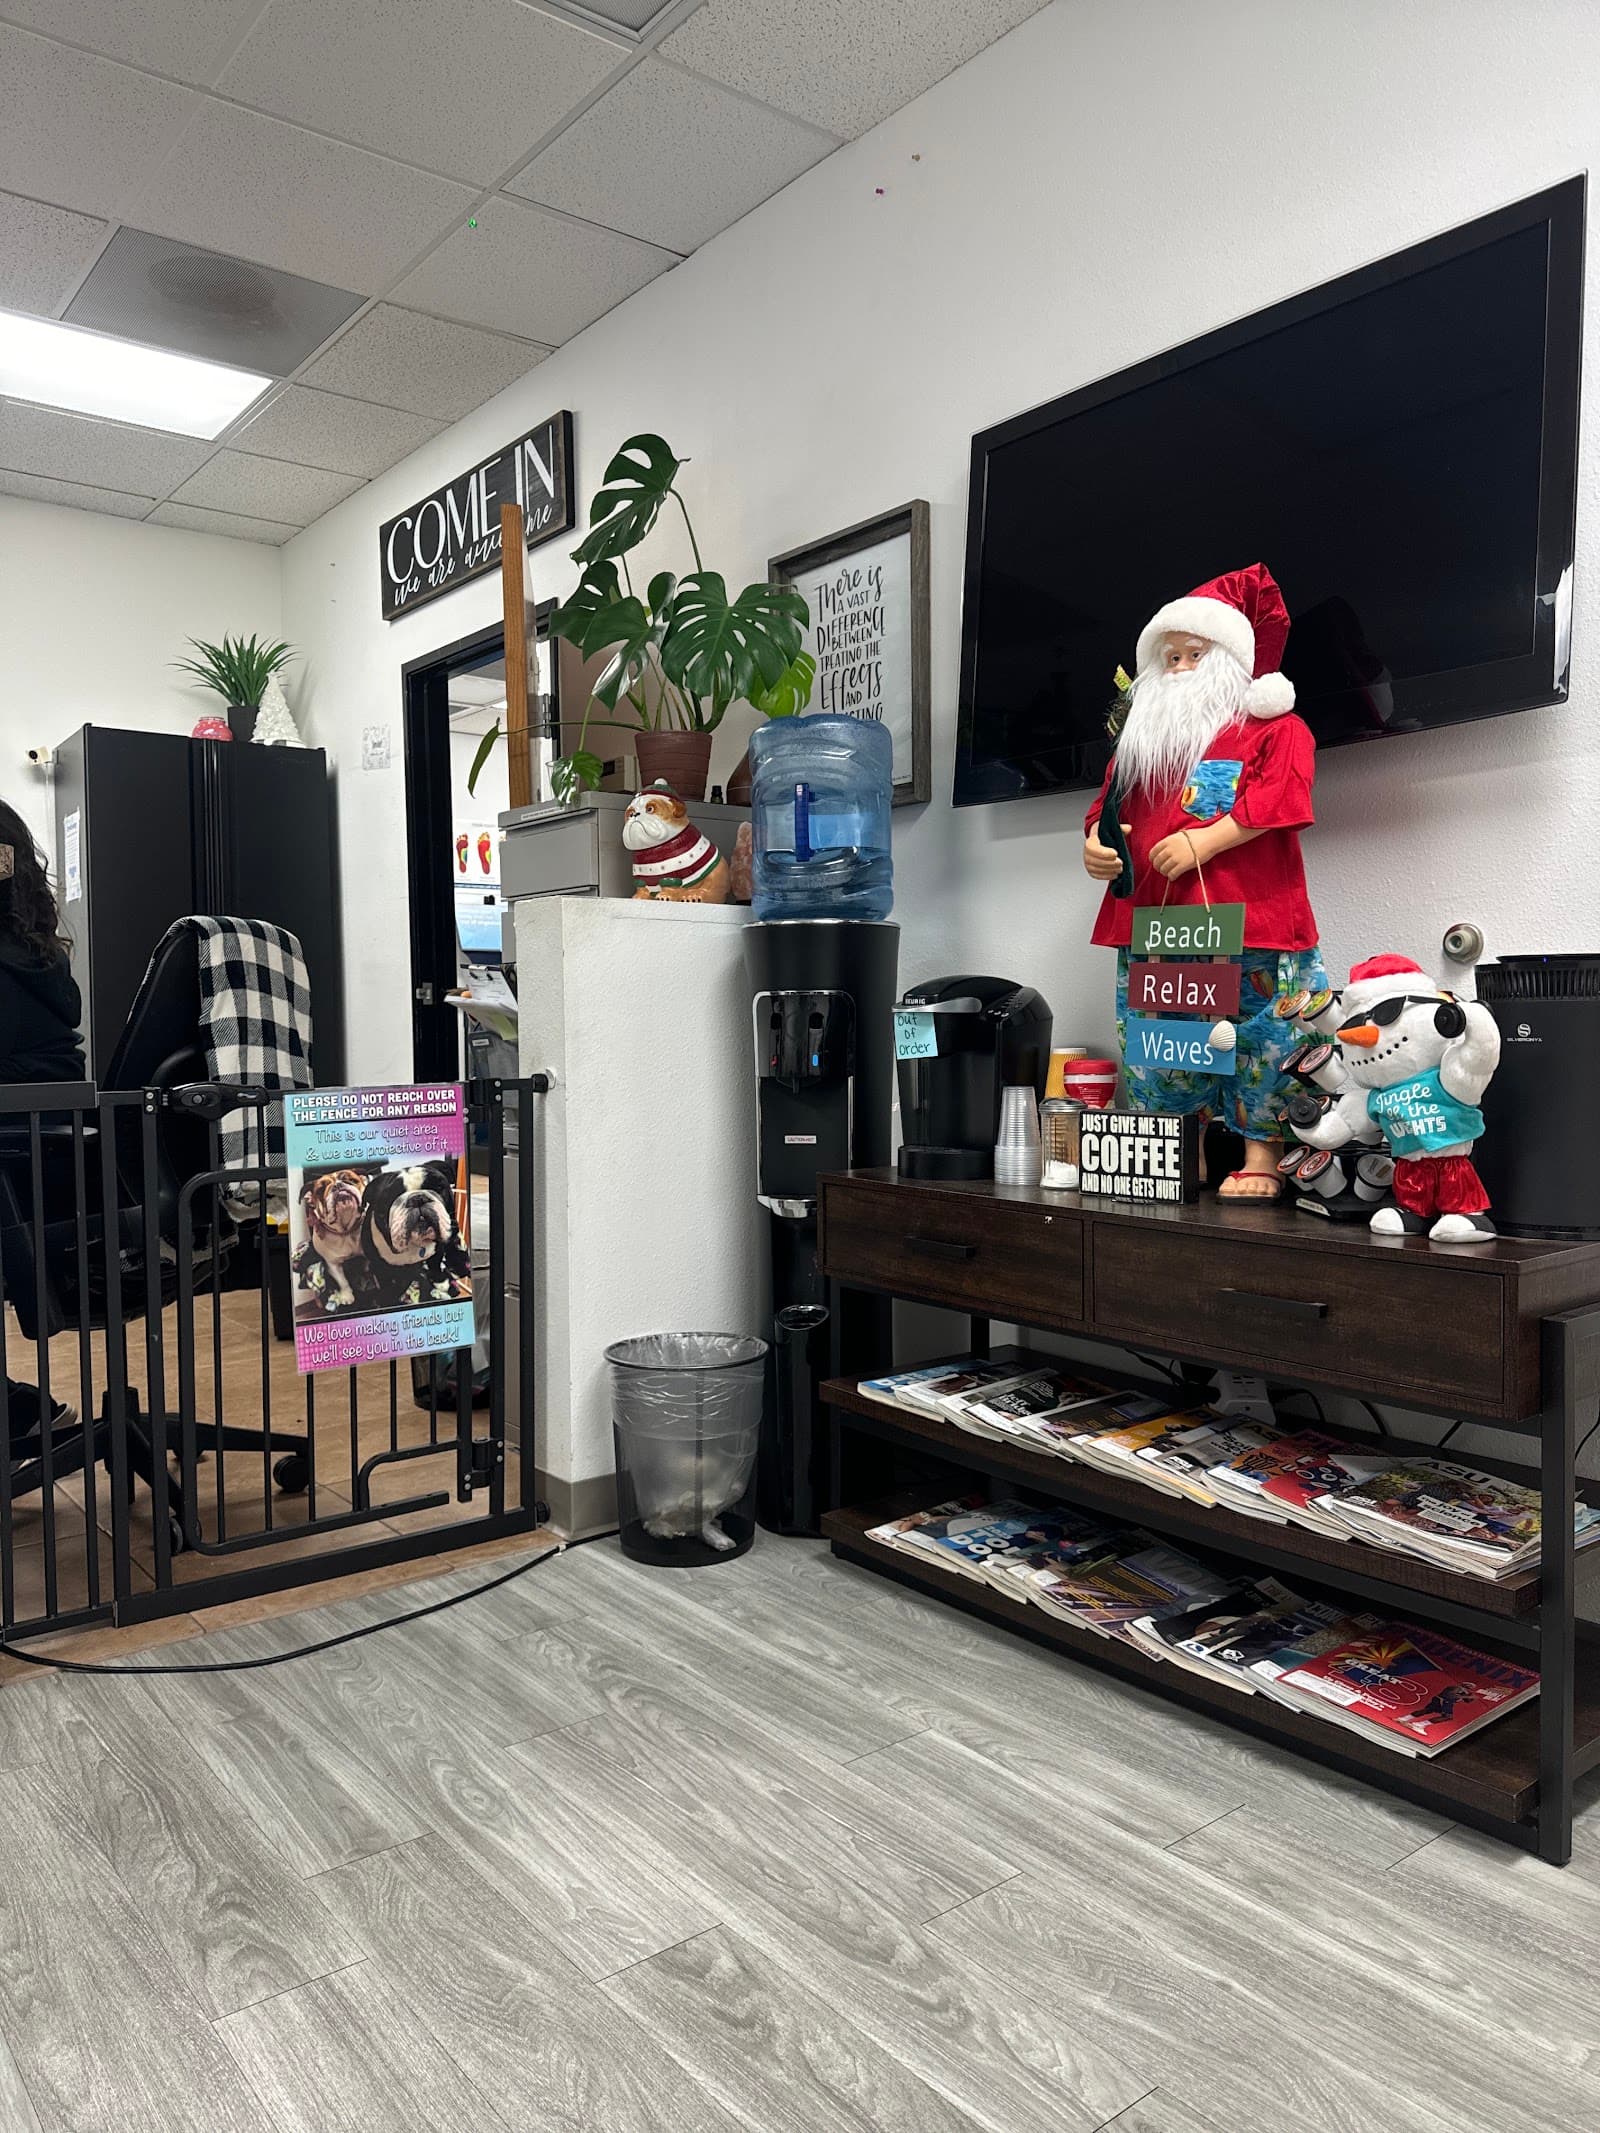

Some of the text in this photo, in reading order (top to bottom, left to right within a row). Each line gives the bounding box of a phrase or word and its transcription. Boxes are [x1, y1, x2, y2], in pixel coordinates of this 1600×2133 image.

[387, 425, 555, 584] COME IN
[394, 575, 421, 606] we
[428, 555, 456, 587] are
[814, 565, 884, 623] There is
[837, 590, 871, 614] A VAST
[817, 606, 886, 656] DIFFERENCE
[832, 624, 873, 652] BETWEEN
[820, 640, 881, 673] TREATING THE
[845, 690, 862, 707] AND
[1149, 917, 1221, 948] Beach
[1143, 973, 1217, 1007] Relax
[904, 1027, 916, 1040] of
[1141, 1031, 1214, 1066] Waves
[293, 1089, 455, 1108] PLEASE DO NOT REACH OVER
[293, 1102, 457, 1122] THE FENCE FOR ANY REASON
[1376, 1083, 1432, 1113] Jingle
[1408, 1102, 1441, 1117] the
[315, 1124, 438, 1143] This is our quiet area
[1082, 1114, 1180, 1137] JUST GIVE ME THE
[305, 1138, 449, 1161] & we are protective of it
[1082, 1133, 1180, 1178] COFFEE
[1082, 1172, 1181, 1200] AND NO ONE GETS HURT
[303, 1308, 464, 1345] We love making friends but
[312, 1327, 460, 1364] we'll see you in the back!
[1417, 1461, 1490, 1485] ASU
